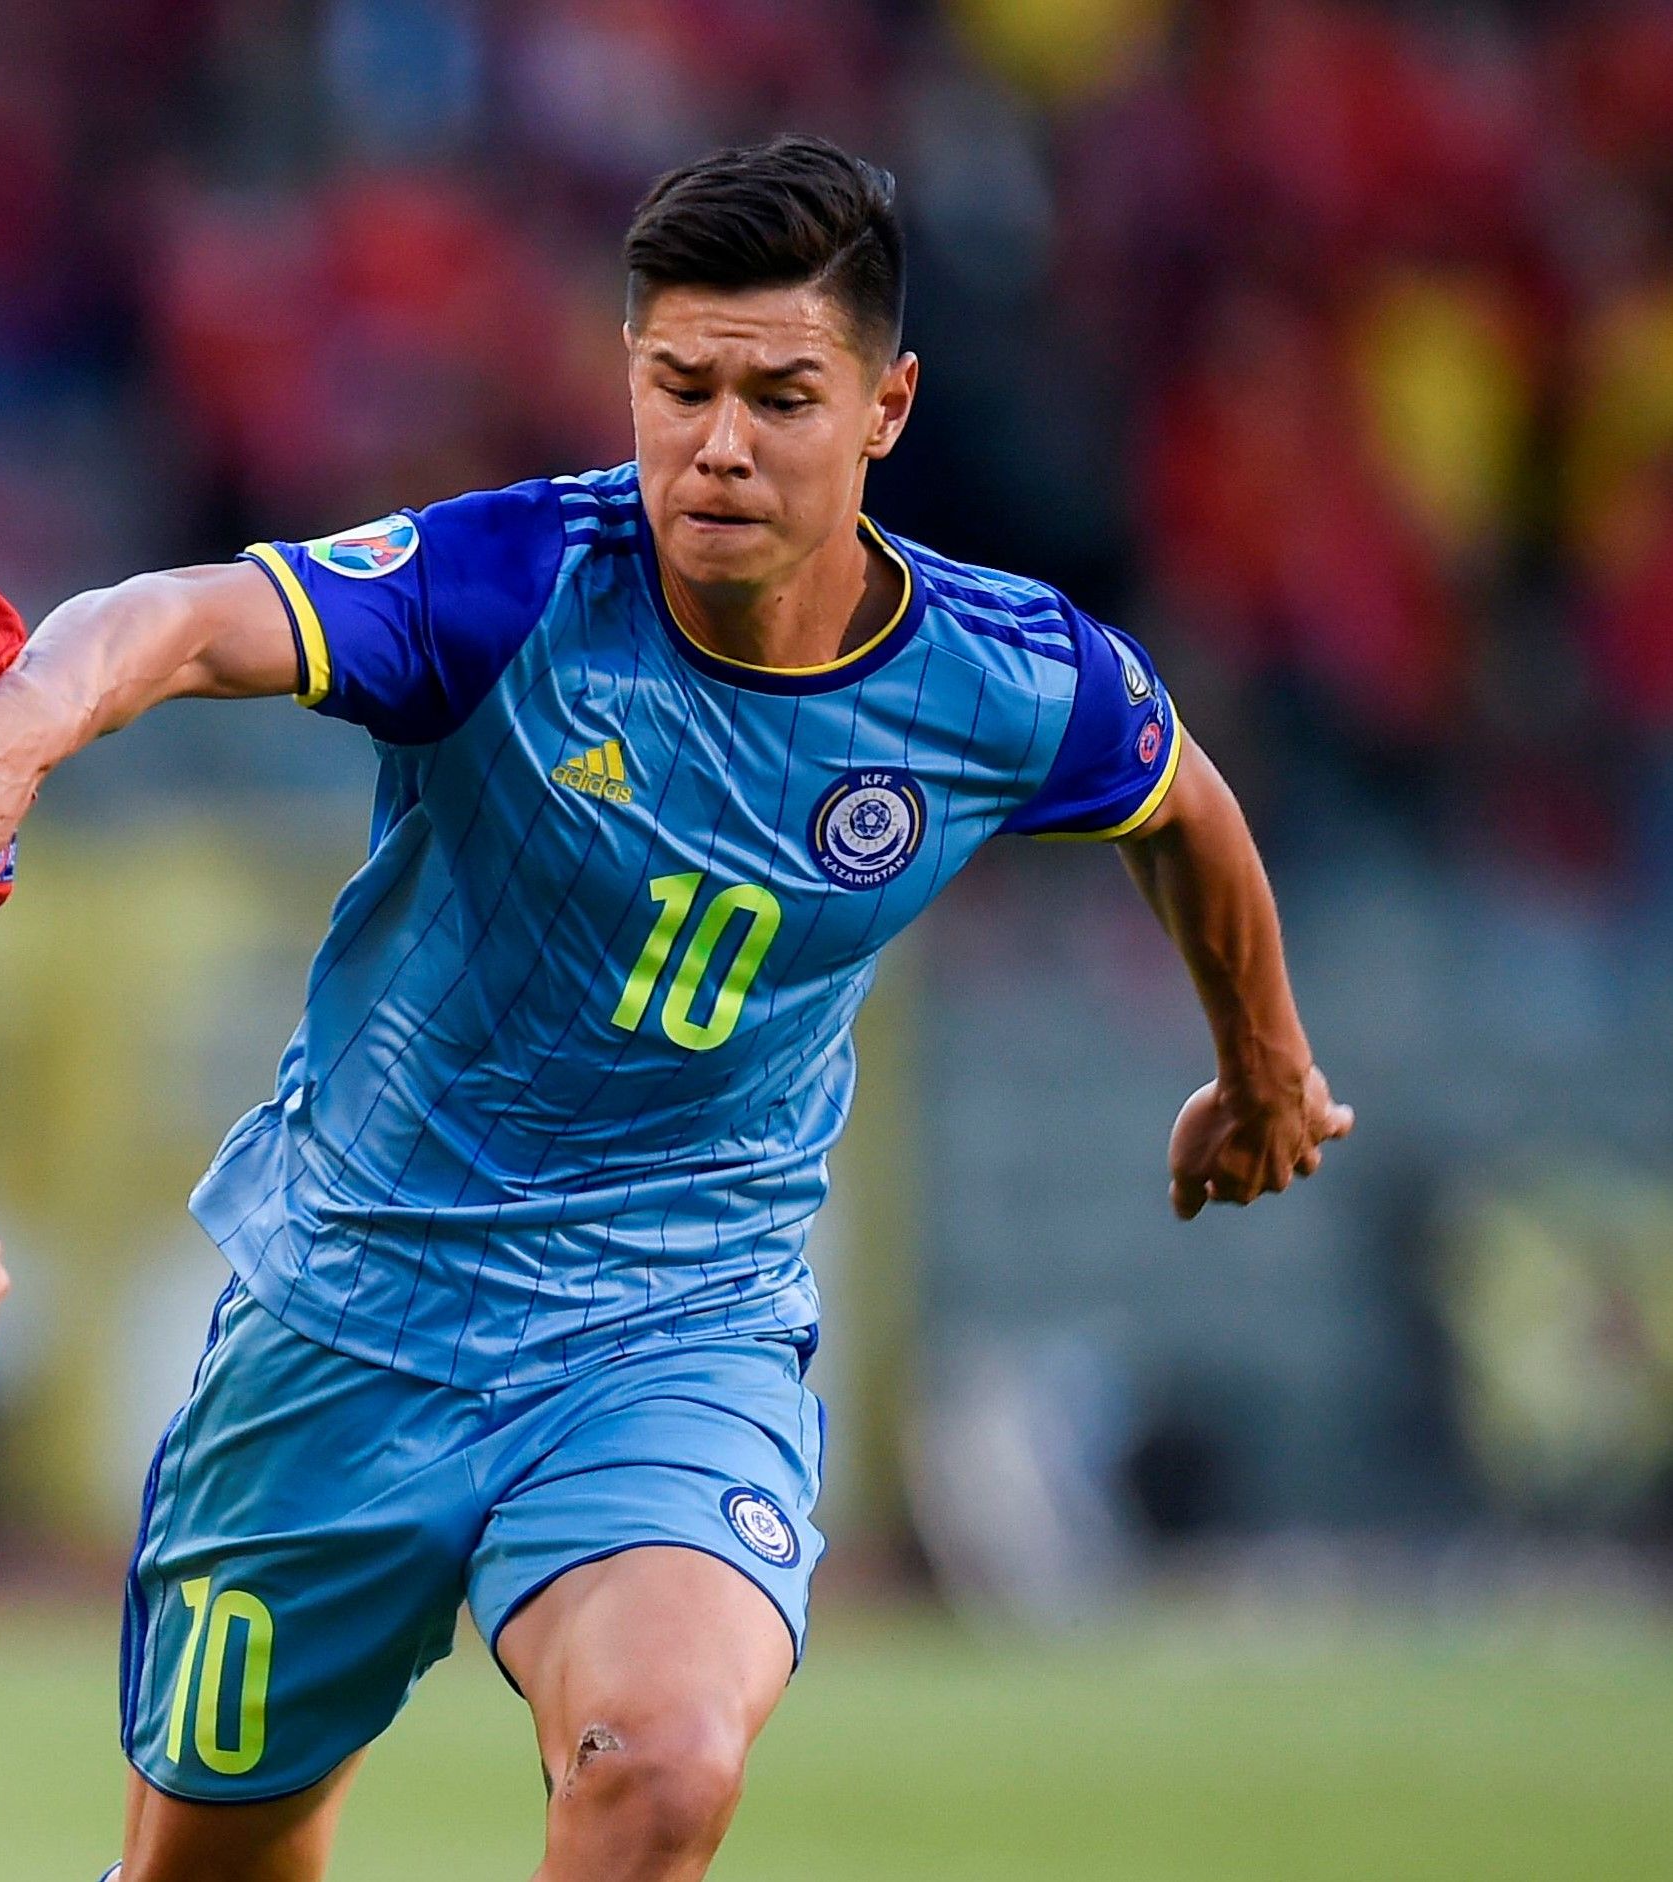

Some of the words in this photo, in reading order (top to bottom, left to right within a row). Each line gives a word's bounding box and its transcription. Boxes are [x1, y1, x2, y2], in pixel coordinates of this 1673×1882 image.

[551, 766, 632, 805] adidas
[860, 773, 893, 787] KFF
[821, 855, 906, 884] KAZAKHSTAN
[611, 871, 781, 1051] 10
[166, 1575, 274, 1775] 10
